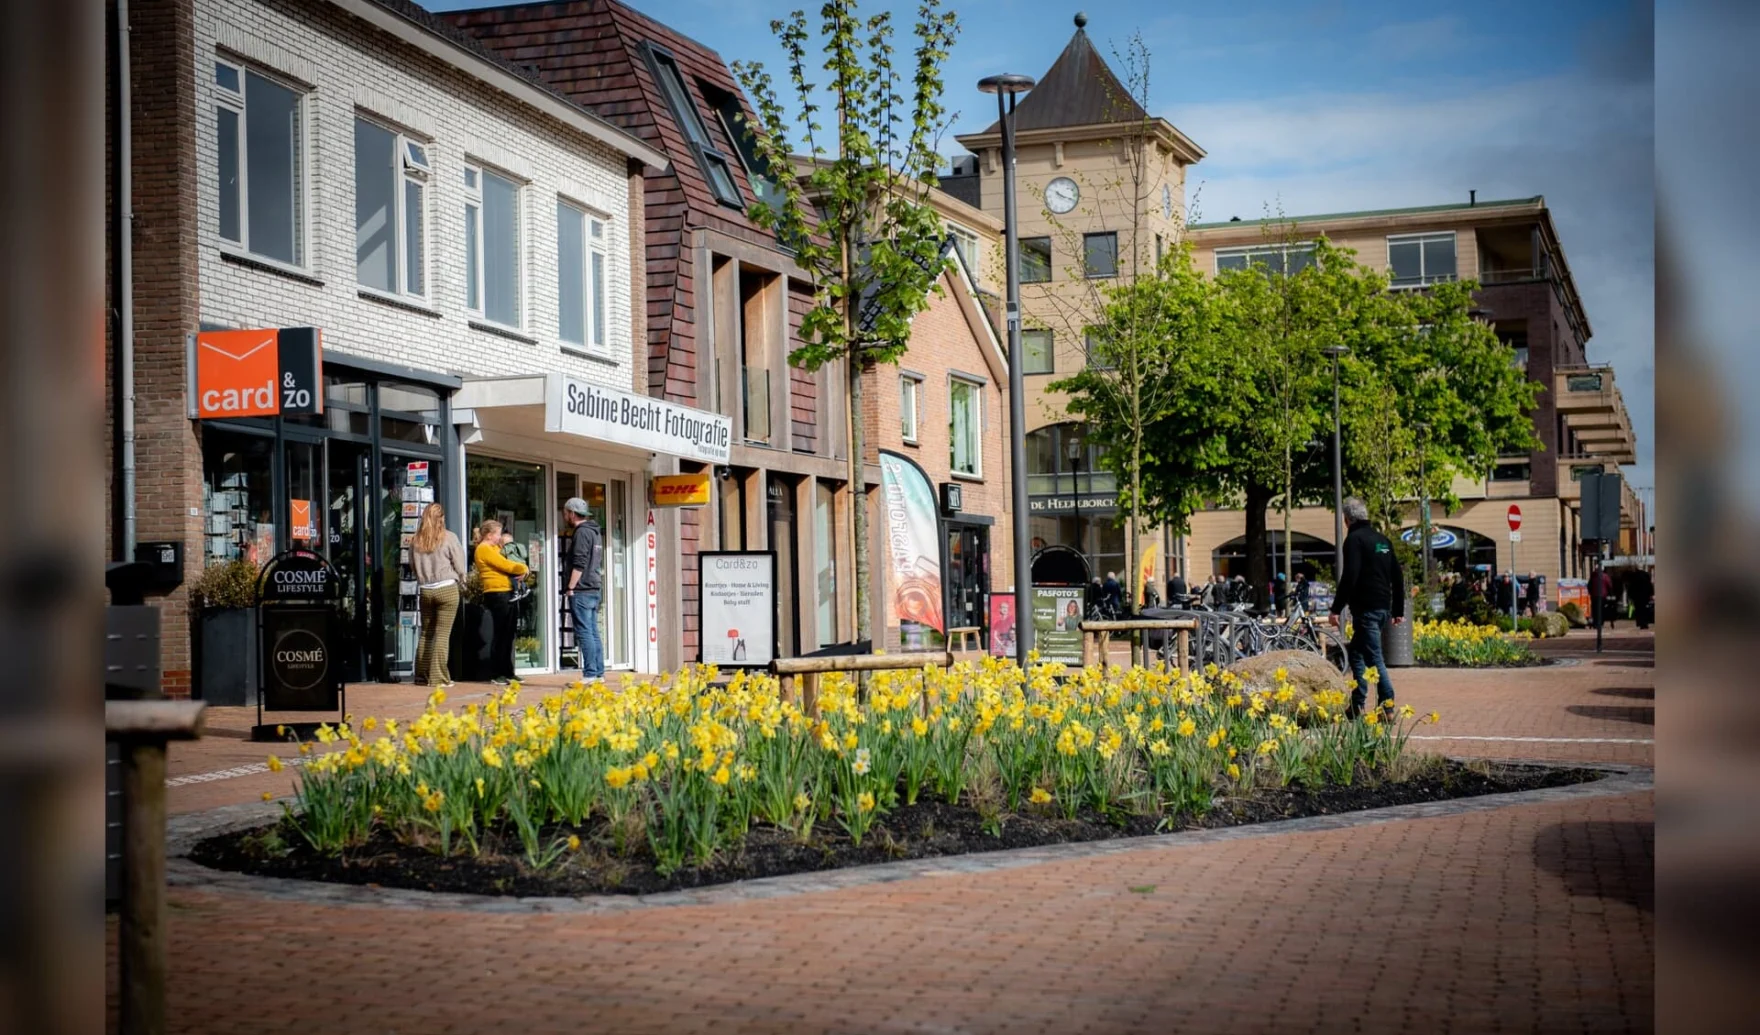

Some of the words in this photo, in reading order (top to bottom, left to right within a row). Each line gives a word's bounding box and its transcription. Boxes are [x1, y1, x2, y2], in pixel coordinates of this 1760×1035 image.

[283, 372, 295, 388] &
[202, 380, 274, 411] card
[284, 389, 310, 408] zo
[567, 383, 618, 424] Sabine
[621, 397, 660, 433] Becht
[665, 408, 728, 447] Fotografie
[660, 484, 699, 495] DHL
[1031, 501, 1045, 510] DE
[292, 523, 309, 536] card
[274, 567, 326, 583] COSMÉ
[277, 584, 324, 593] LIFESTYLE
[277, 647, 323, 662] COSMÉ
